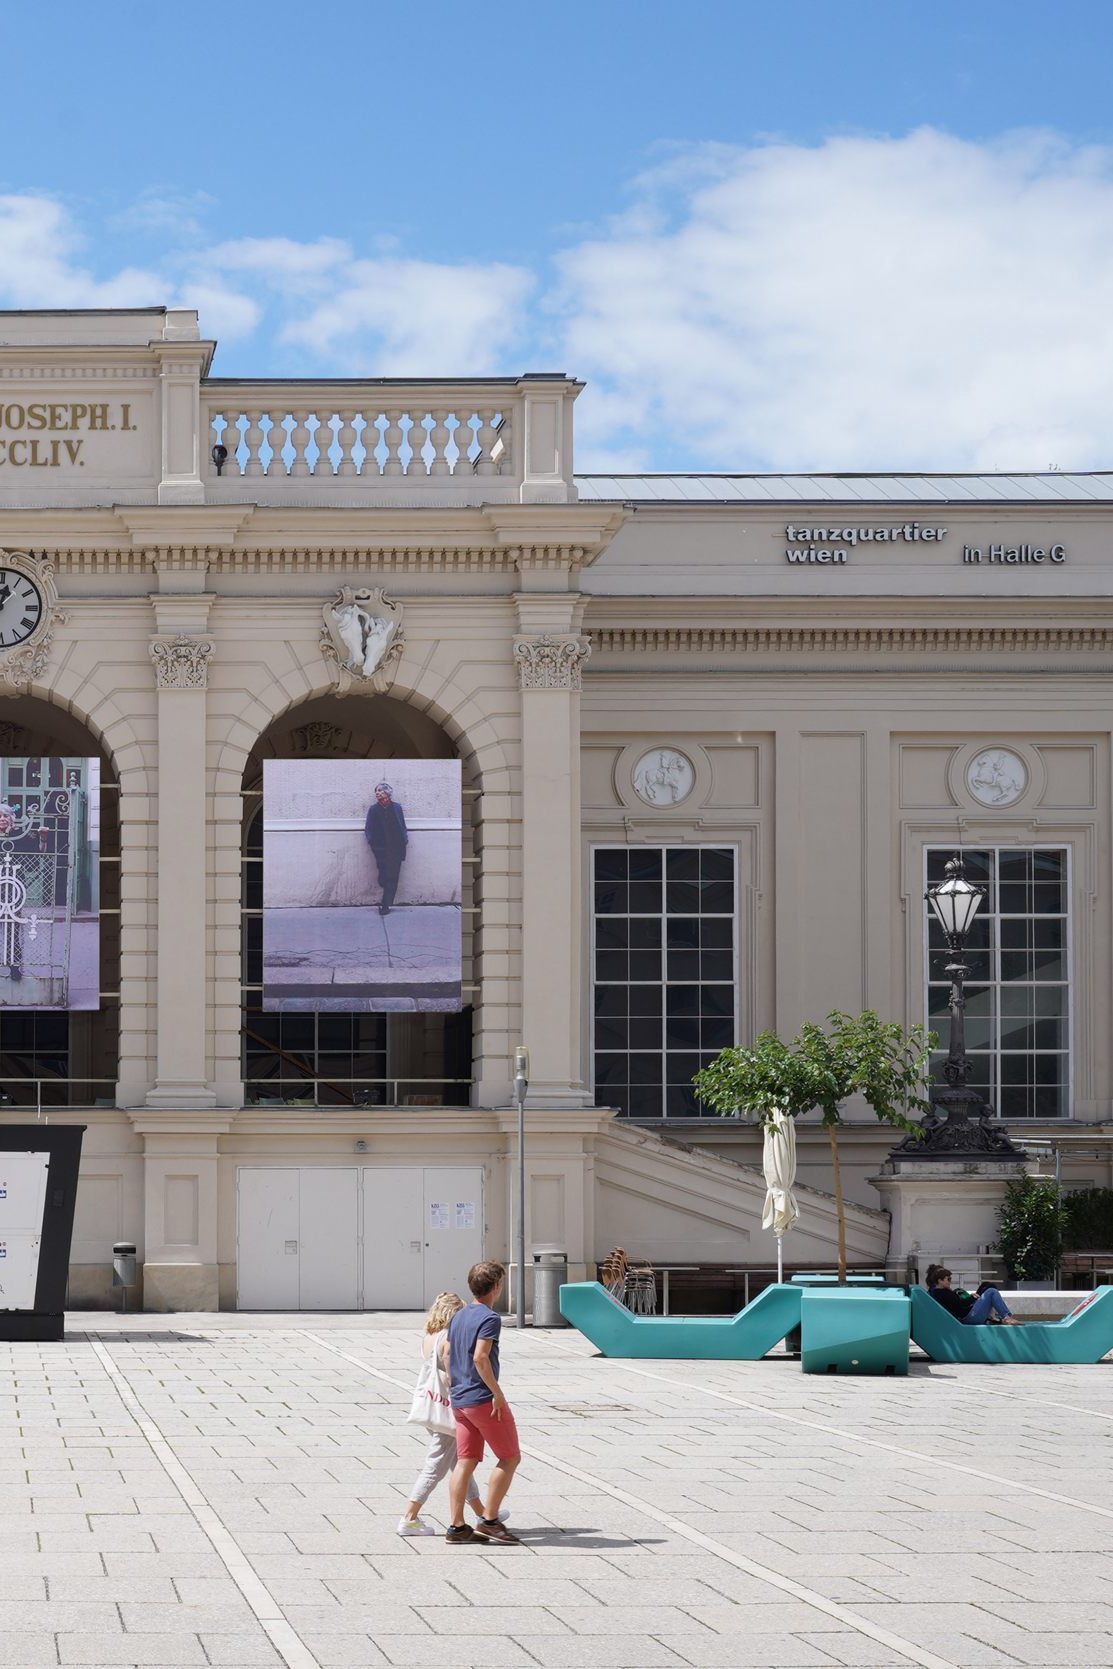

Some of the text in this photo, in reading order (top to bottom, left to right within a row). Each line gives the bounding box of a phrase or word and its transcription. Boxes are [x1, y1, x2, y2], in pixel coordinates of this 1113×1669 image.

[786, 522, 948, 546] tanzquartier
[786, 544, 848, 563] wien
[962, 544, 1067, 563] in Halle G
